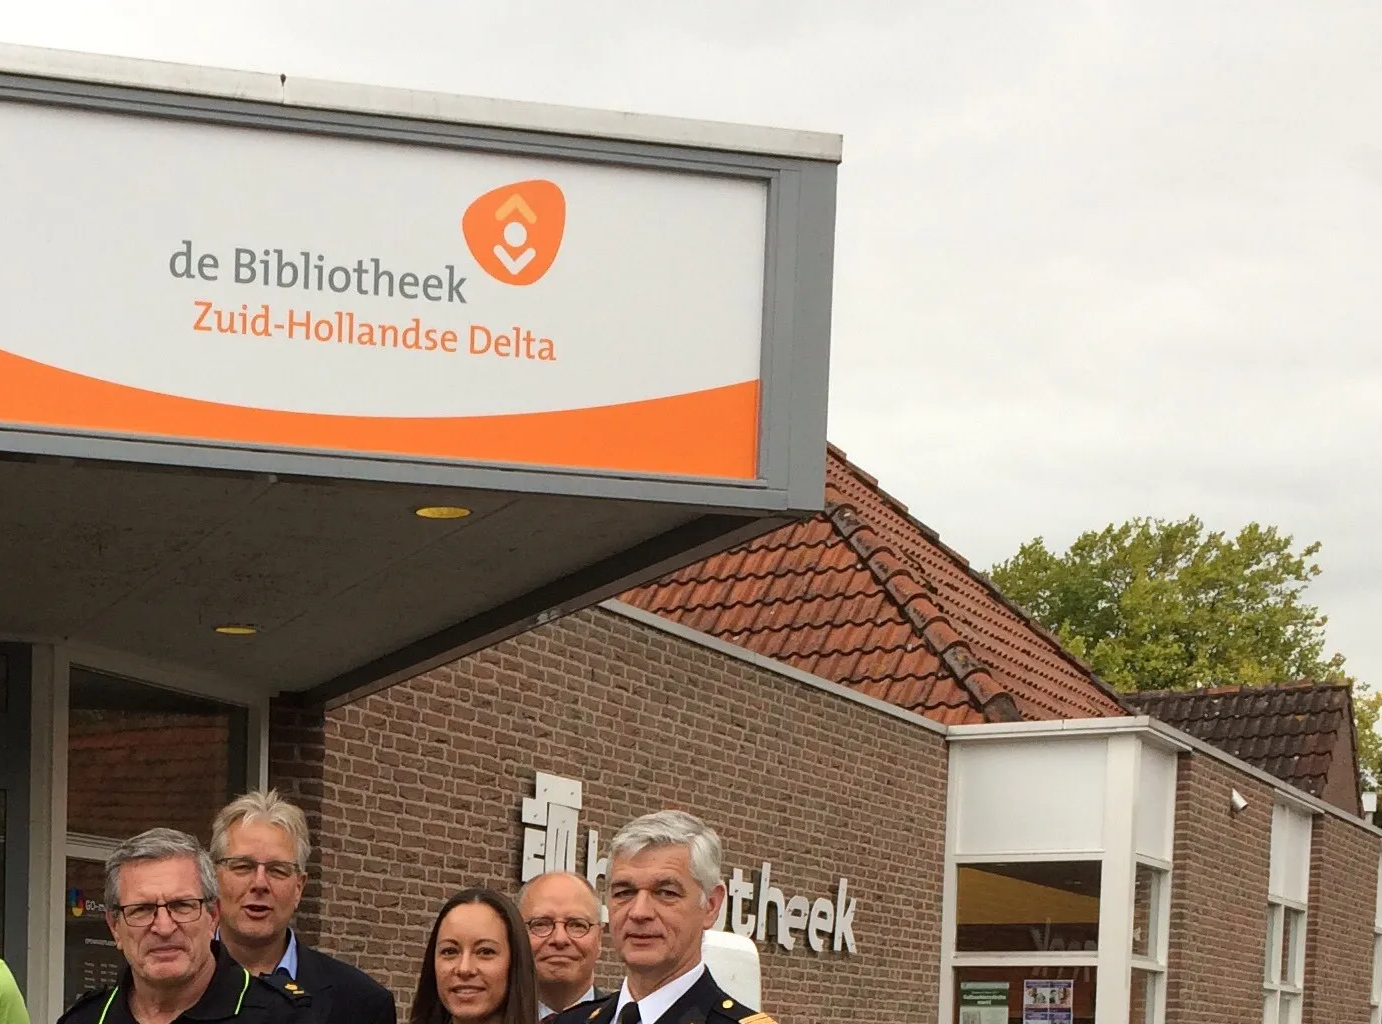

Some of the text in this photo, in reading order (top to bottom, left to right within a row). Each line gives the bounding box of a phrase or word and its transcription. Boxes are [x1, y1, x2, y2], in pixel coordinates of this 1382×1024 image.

[169, 240, 468, 304] de Bibliotheek
[193, 300, 557, 361] Zuid-Hollandse Delta
